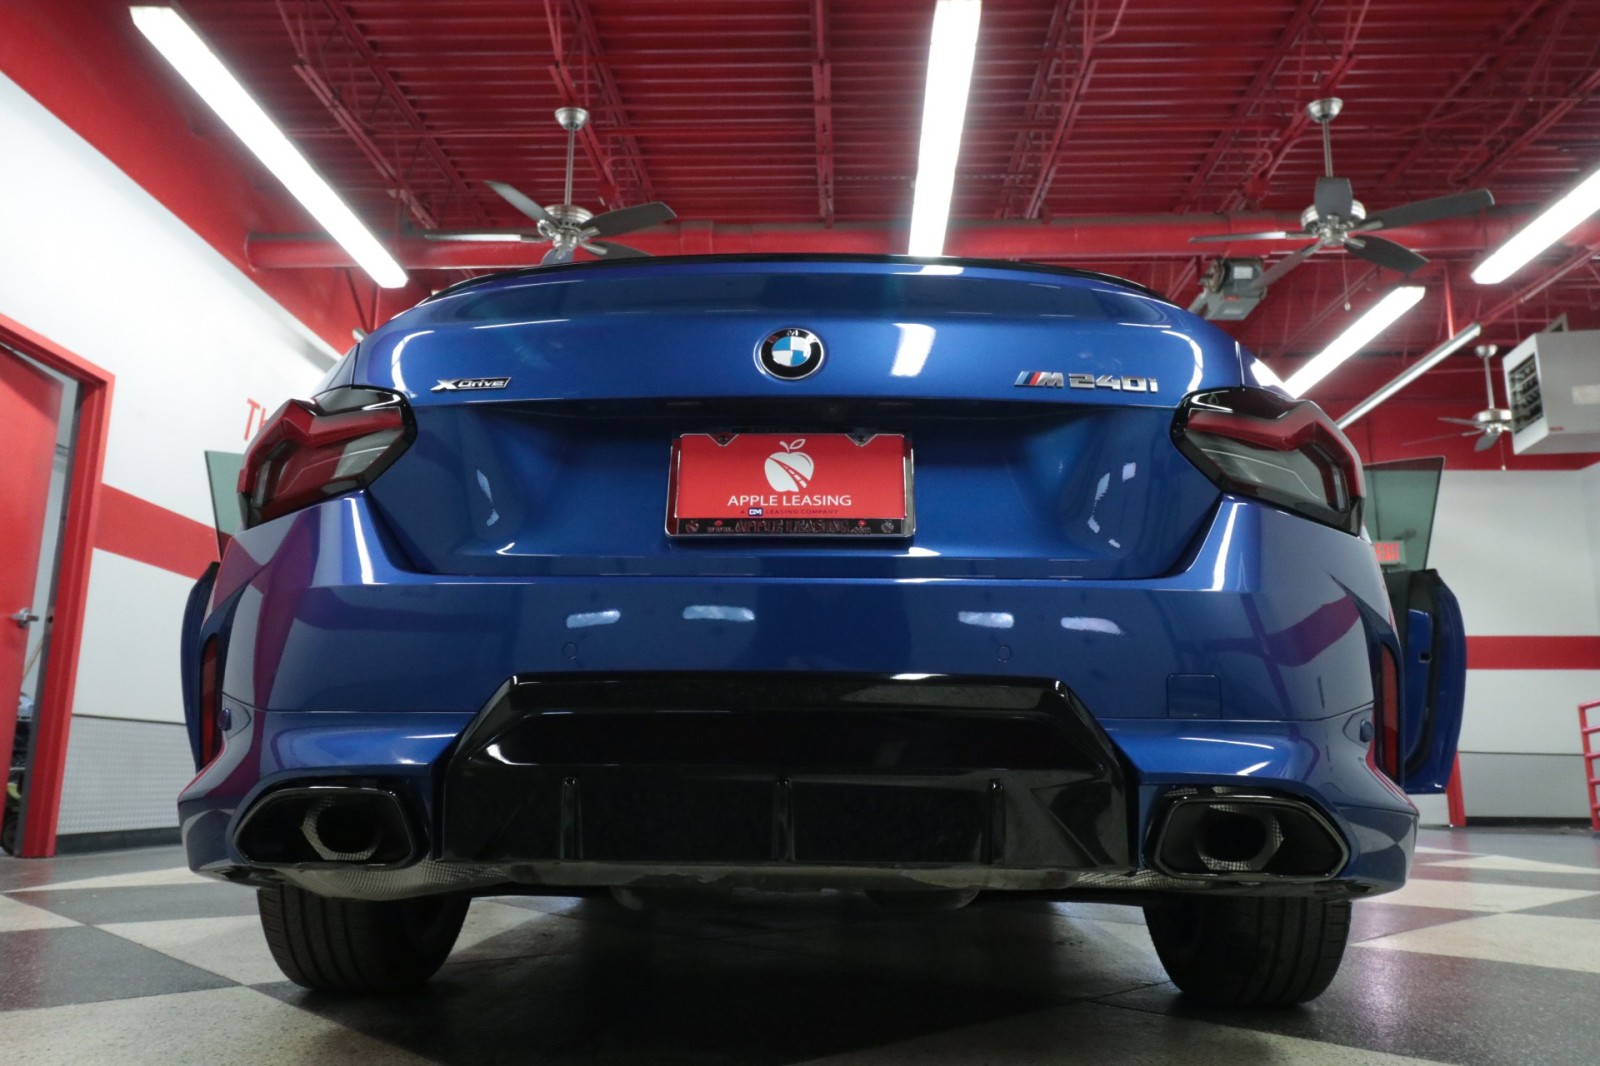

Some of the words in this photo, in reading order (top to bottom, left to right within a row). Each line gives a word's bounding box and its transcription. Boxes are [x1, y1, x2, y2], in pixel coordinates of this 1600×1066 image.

[767, 329, 819, 344] BM
[727, 495, 778, 506] APPLE
[783, 495, 852, 506] LEASING
